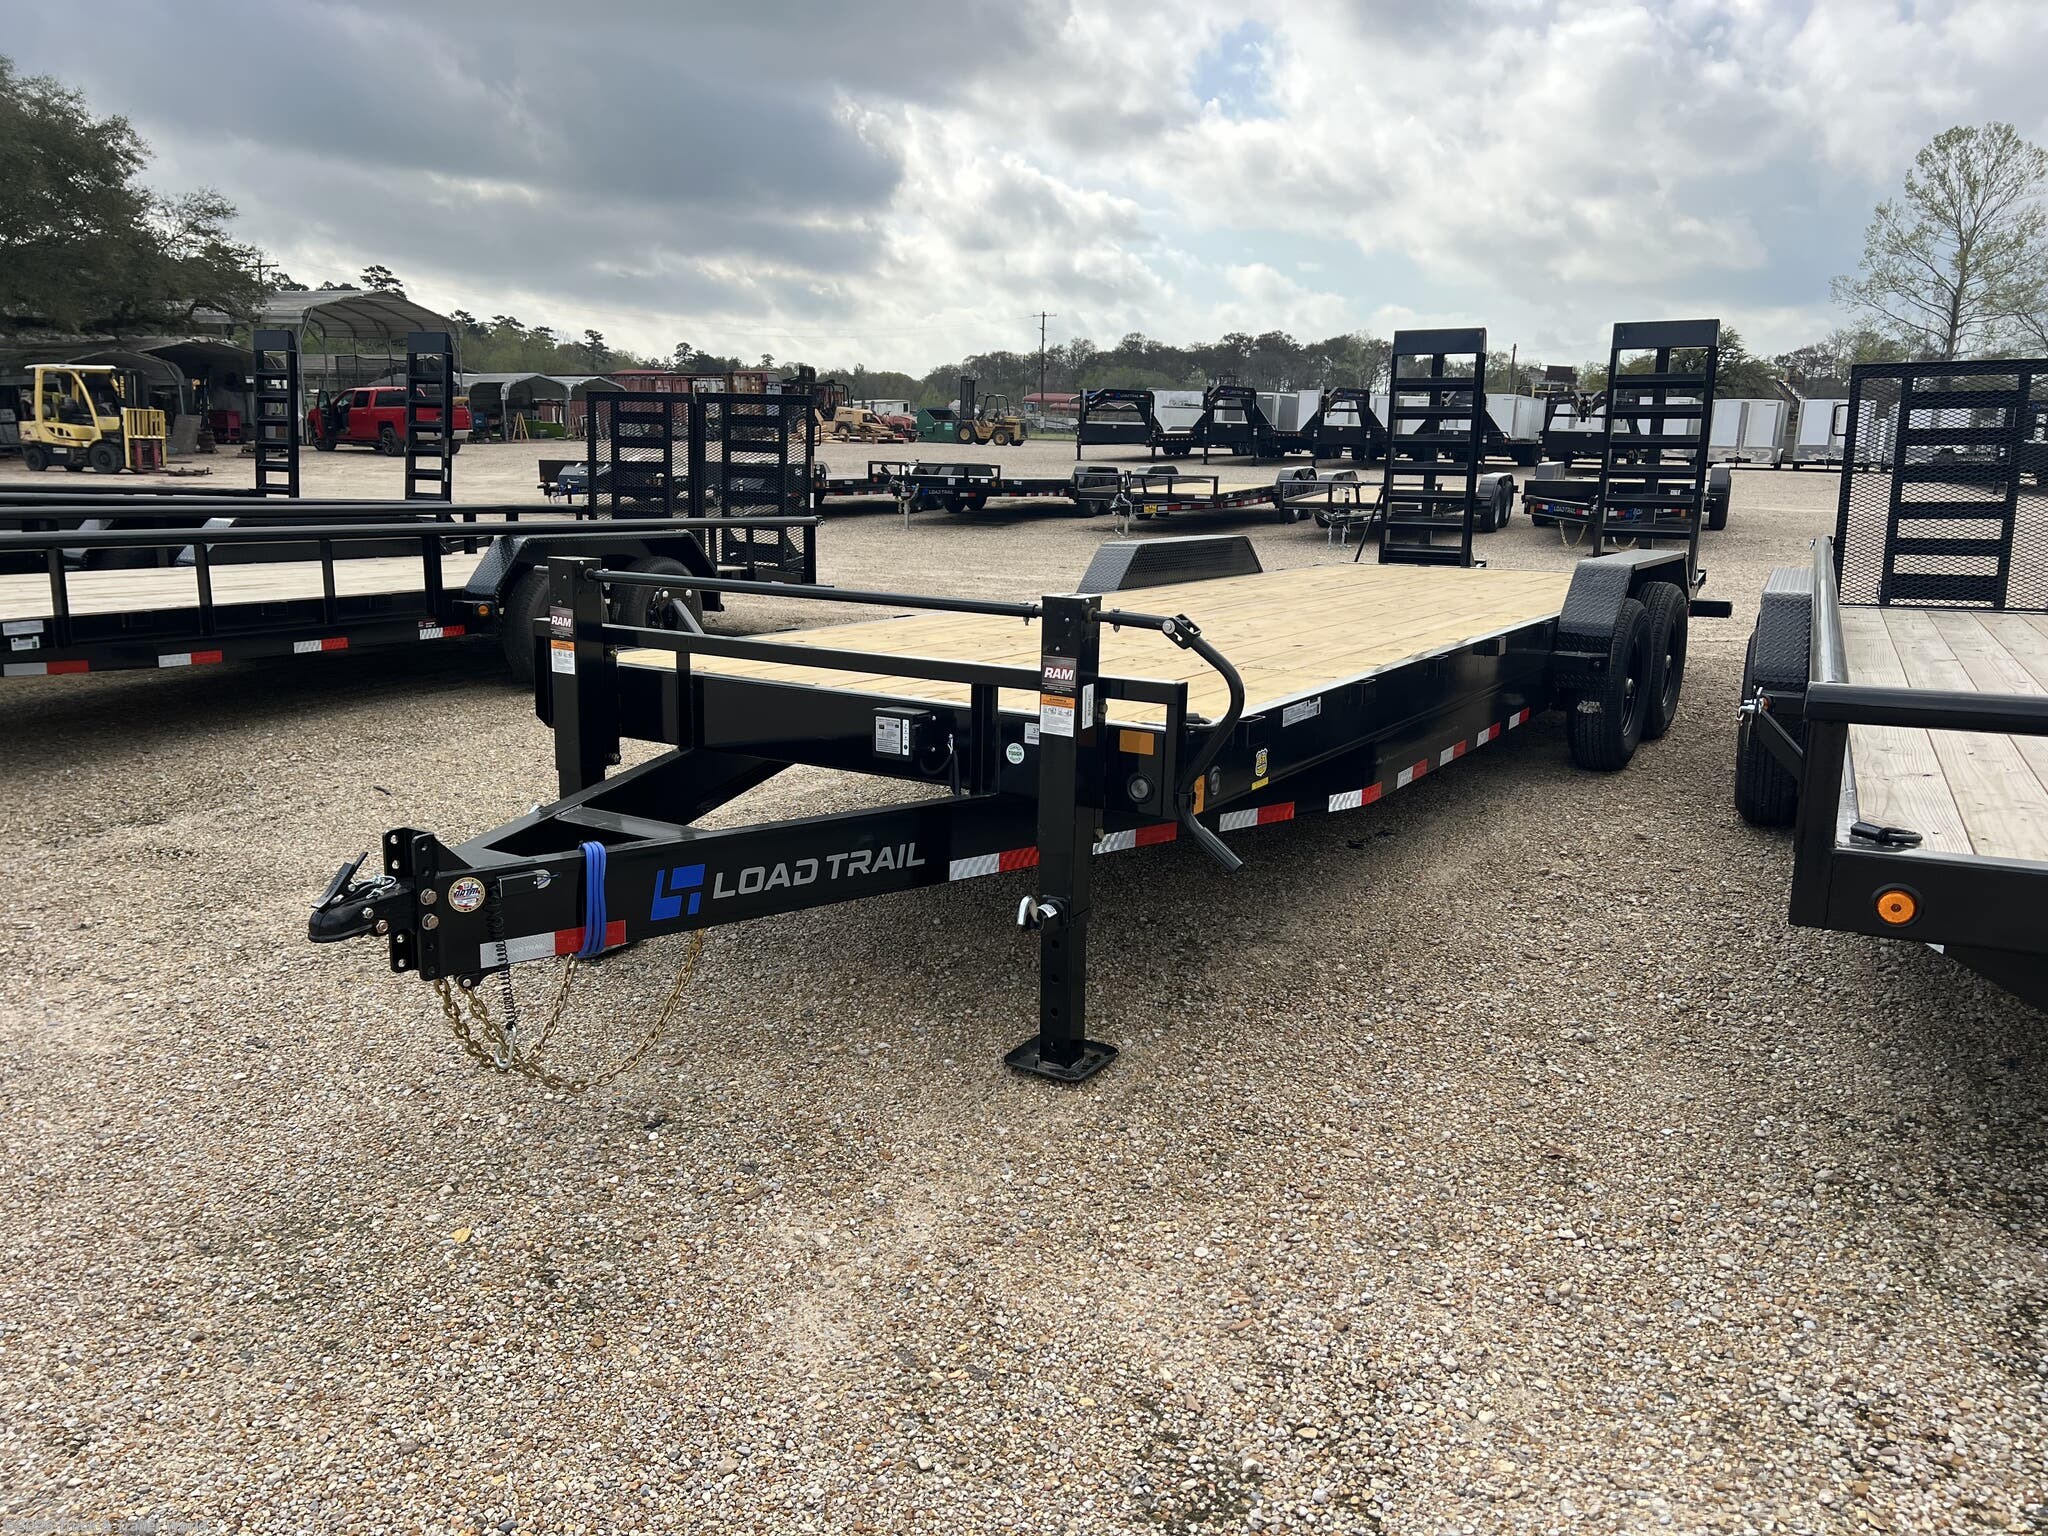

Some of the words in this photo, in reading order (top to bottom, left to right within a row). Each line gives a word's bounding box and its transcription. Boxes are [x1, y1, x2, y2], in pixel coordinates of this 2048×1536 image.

[551, 615, 572, 628] RAM
[1044, 667, 1074, 681] RAM
[712, 858, 819, 900] LOAD
[826, 842, 926, 880] TRAIL
